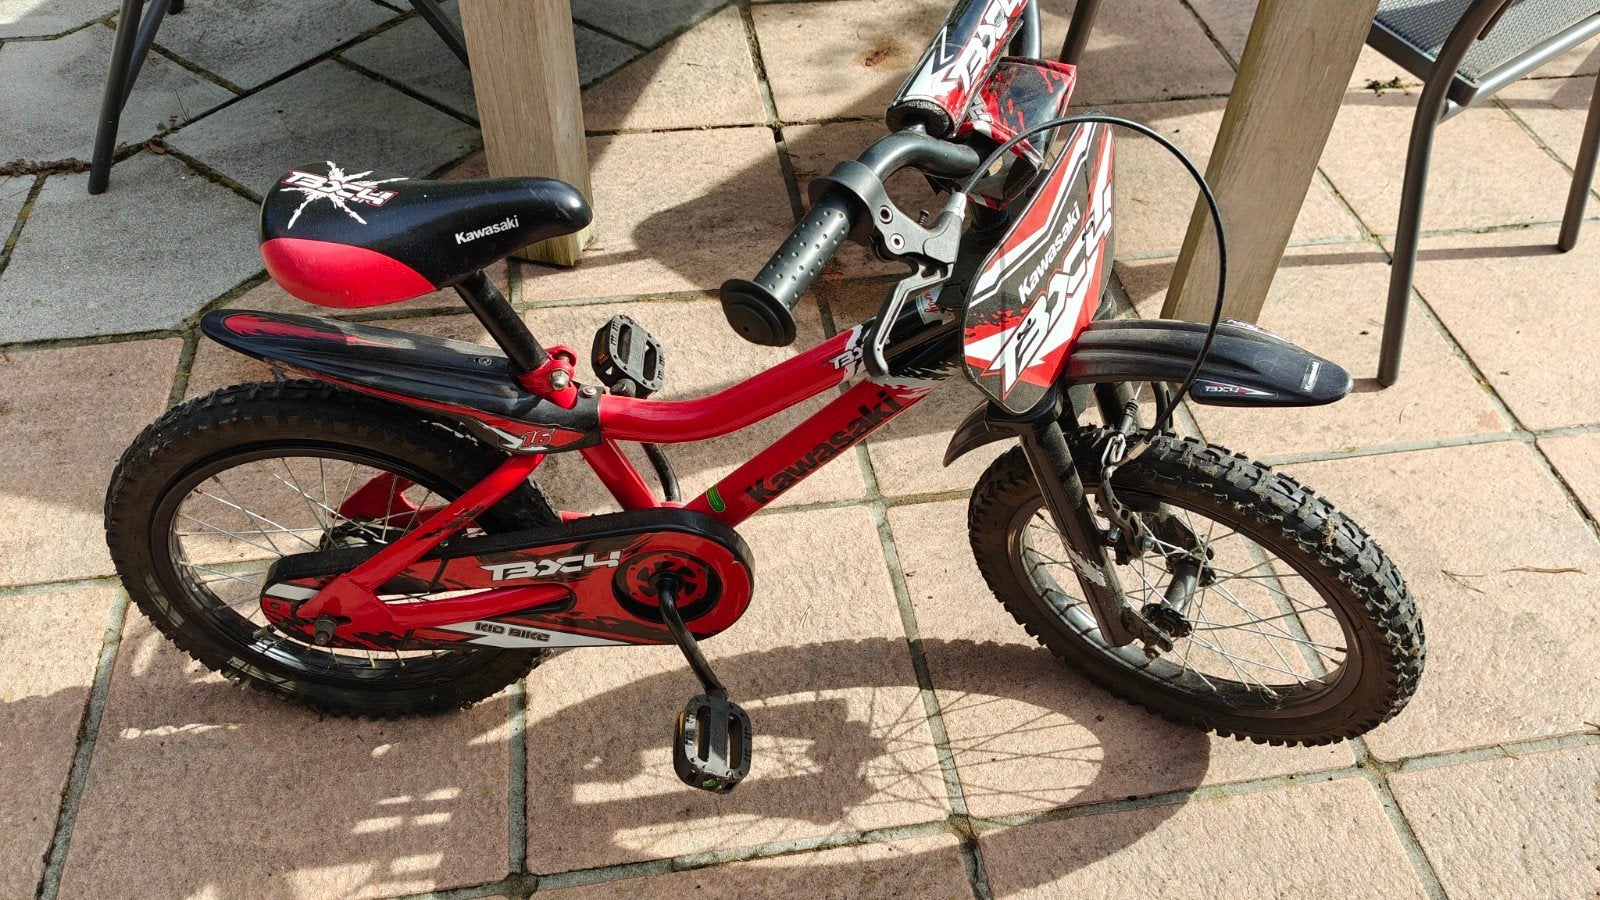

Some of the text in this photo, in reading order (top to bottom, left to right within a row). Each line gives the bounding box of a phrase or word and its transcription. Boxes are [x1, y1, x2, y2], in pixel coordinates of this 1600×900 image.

[455, 214, 519, 245] Kawasaki
[1017, 201, 1081, 304] Kawasaki
[518, 429, 555, 449] 16
[746, 391, 904, 504] Kawasaki
[475, 621, 550, 642] KID BIKE
